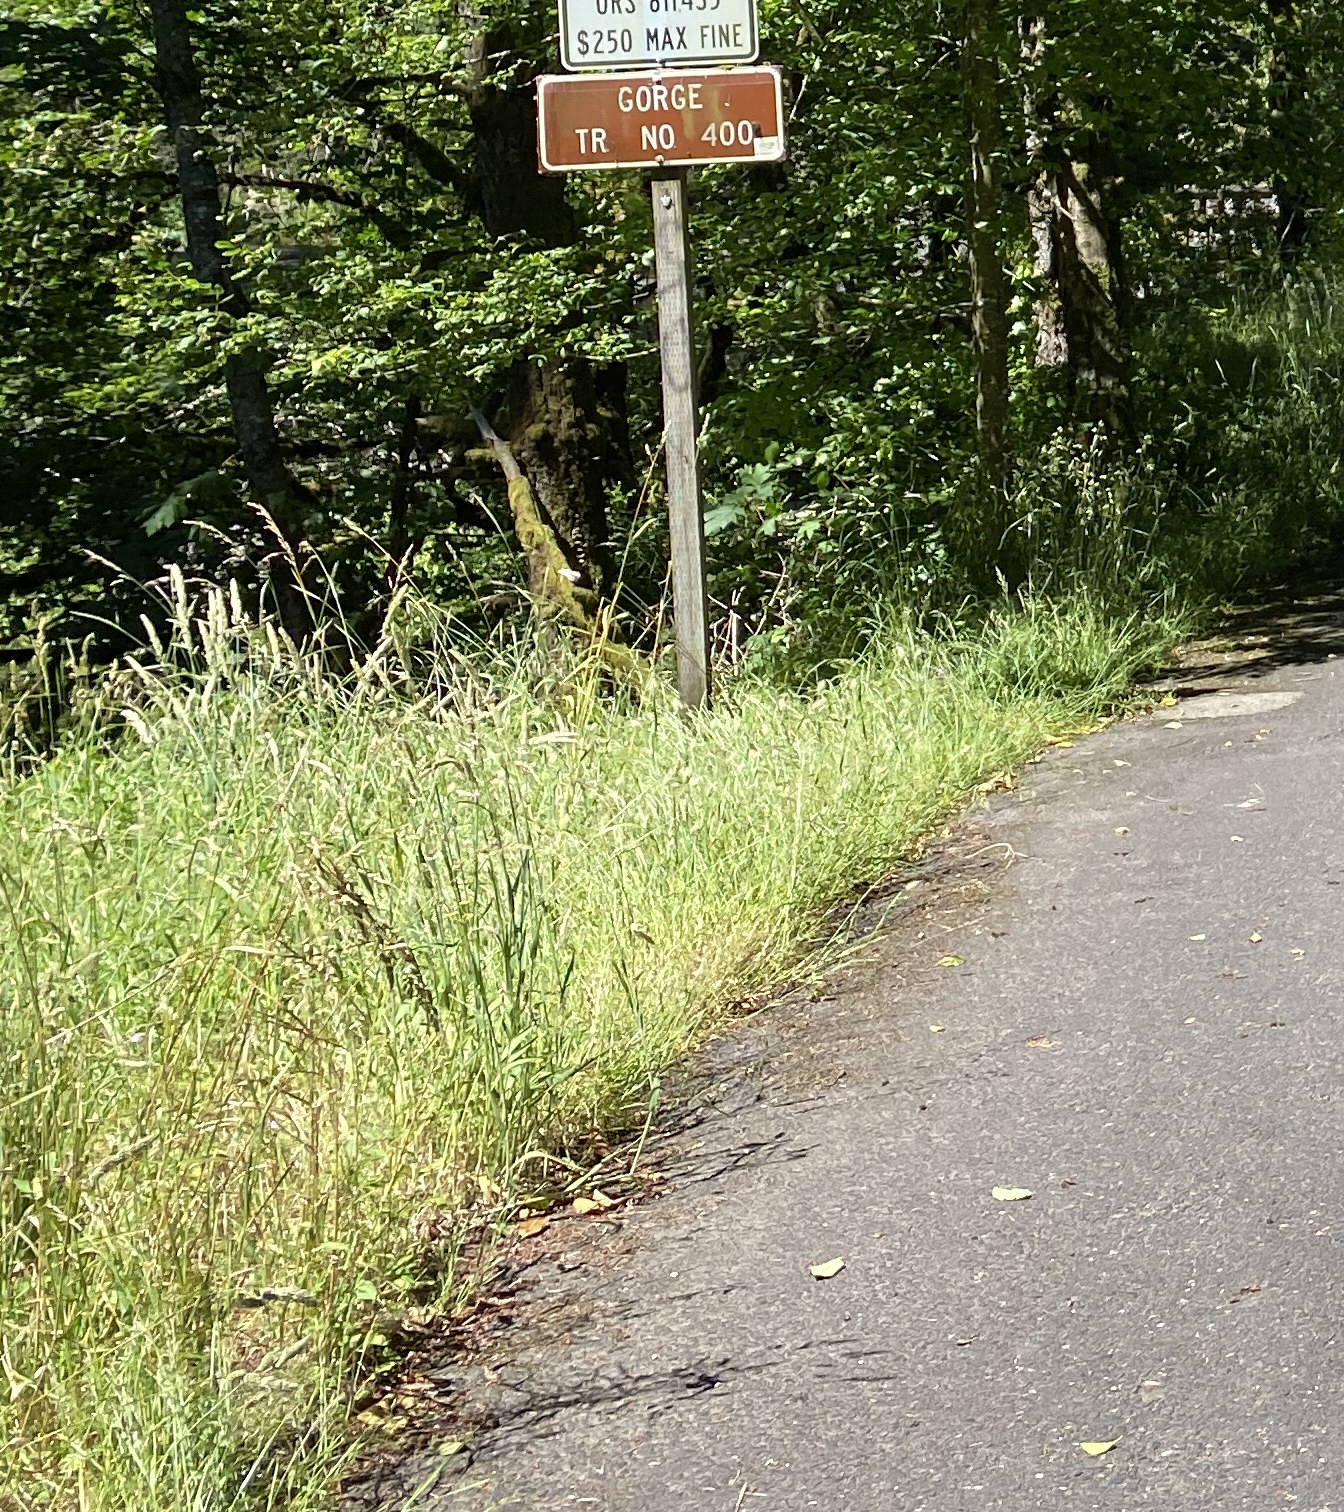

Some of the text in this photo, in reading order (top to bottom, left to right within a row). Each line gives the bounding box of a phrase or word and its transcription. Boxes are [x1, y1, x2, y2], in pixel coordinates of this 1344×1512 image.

[577, 22, 743, 57] $250 MAX FINE
[618, 83, 703, 112] GORGE
[575, 120, 753, 154] TR NO 400
